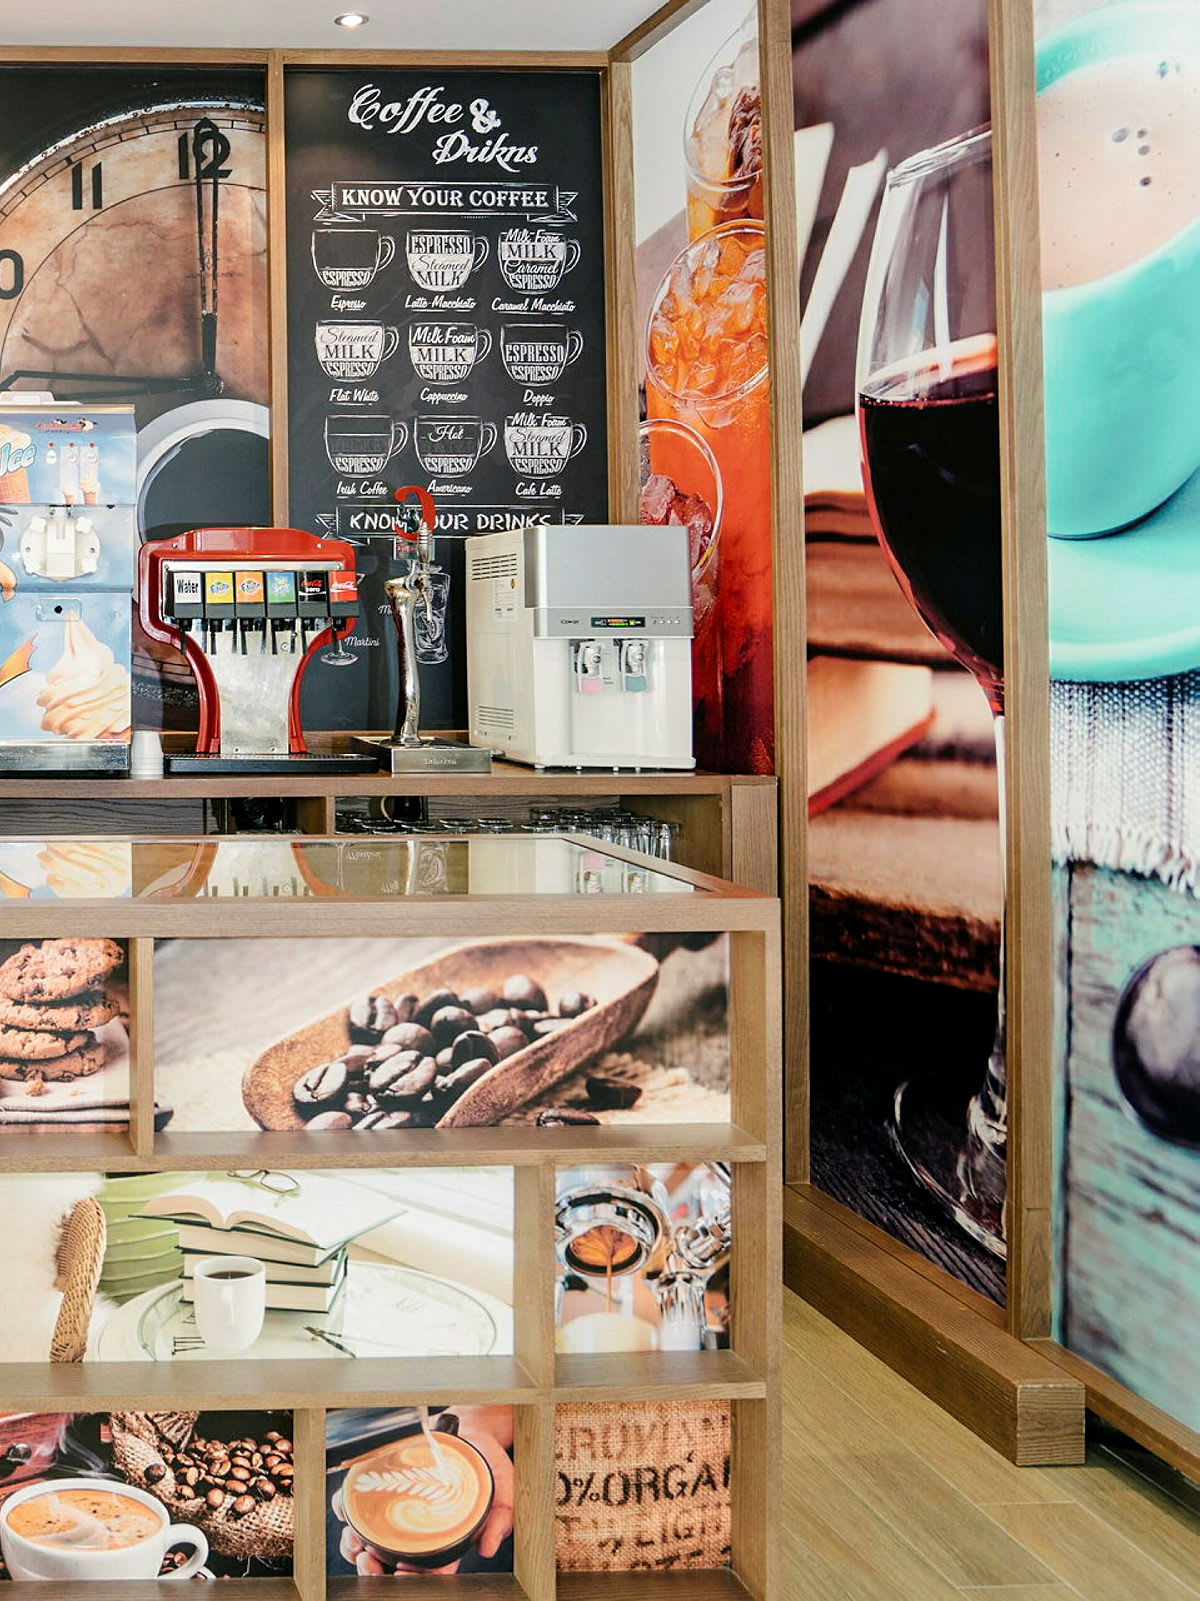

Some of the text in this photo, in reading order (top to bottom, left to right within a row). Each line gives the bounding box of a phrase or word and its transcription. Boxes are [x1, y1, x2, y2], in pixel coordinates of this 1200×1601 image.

[348, 84, 501, 134] Coffee &
[178, 130, 233, 180] 12
[71, 162, 103, 211] 11
[341, 185, 549, 208] KNOW YOUR COFFEE
[505, 228, 531, 244] Milk
[411, 235, 471, 255] ESPRESSO
[507, 244, 556, 259] MILK
[412, 254, 470, 271] Steamed
[504, 258, 560, 275] Caramel
[322, 270, 371, 287] ESPRESSO
[416, 270, 464, 287] MILK
[509, 274, 558, 290] ESPRESSO
[491, 296, 576, 312] Caramel Macchiato
[321, 327, 379, 343] Steamed
[412, 325, 475, 344] Milk Foam
[324, 344, 375, 359] MILK
[417, 347, 467, 362] MILK
[505, 343, 565, 362] ESPRESSO
[326, 361, 375, 378] ESPRESSO
[419, 364, 468, 381] ESPRESSO
[510, 365, 560, 382] ESPRESSO
[329, 388, 380, 402] Flat White
[523, 389, 555, 407] Doppio
[511, 412, 538, 427] Milk
[428, 424, 465, 443] Hot
[512, 441, 562, 457] MILK
[335, 457, 384, 473] ESPRESSO
[424, 457, 473, 473] ESPRESSO
[515, 458, 563, 475] ESPRESSO
[336, 480, 389, 495] Irish Coffee
[427, 479, 473, 494] Americano
[515, 482, 538, 496] Cafe
[476, 513, 551, 531] DRINKS
[177, 579, 199, 594] Water
[344, 636, 381, 647] Martini
